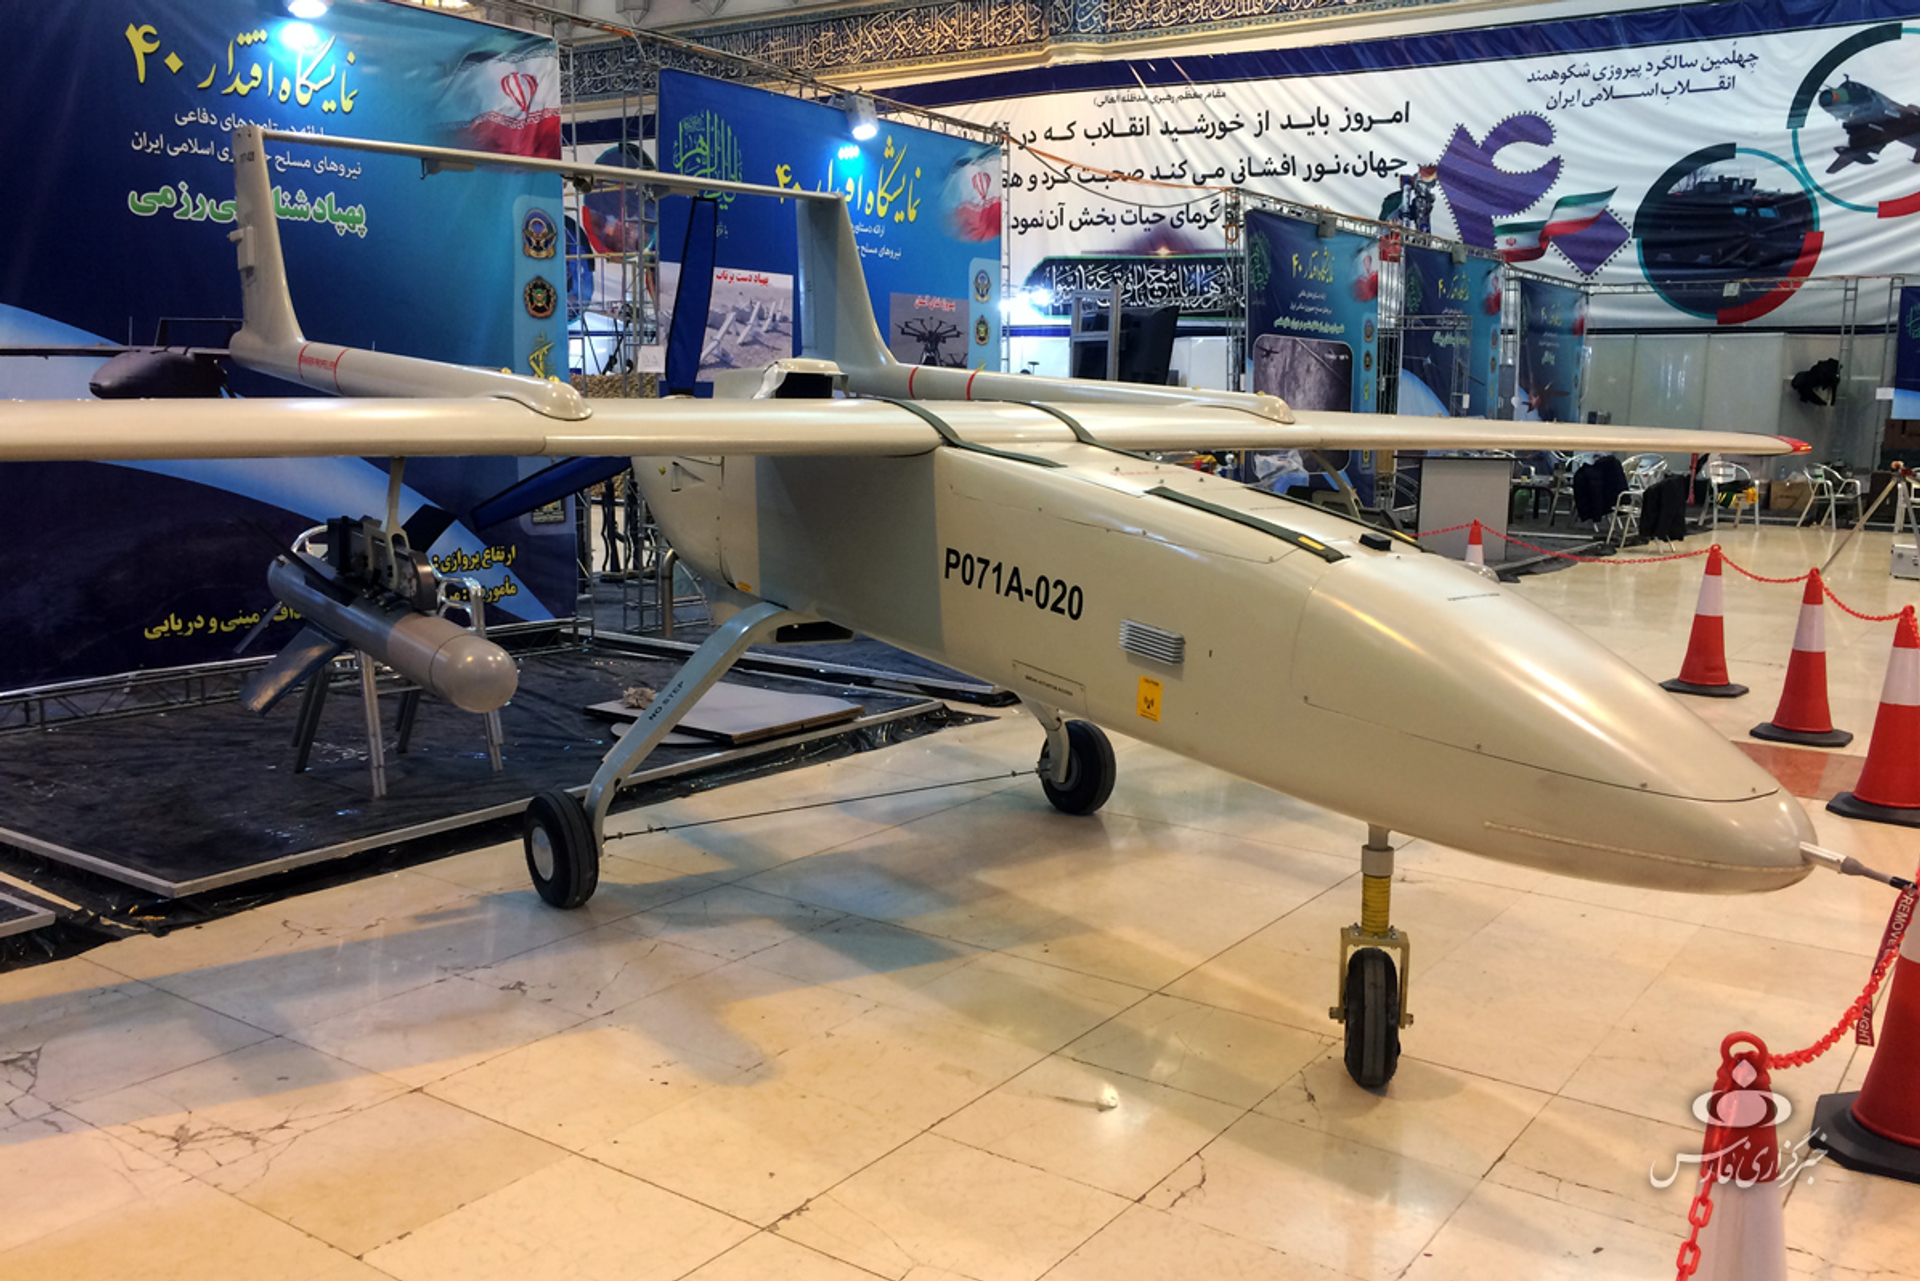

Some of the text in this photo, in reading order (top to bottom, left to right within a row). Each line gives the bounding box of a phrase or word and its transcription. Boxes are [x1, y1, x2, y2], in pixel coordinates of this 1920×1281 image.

[197, 29, 274, 96] اقتدار
[1526, 62, 1591, 85] شکوهمند
[1546, 90, 1581, 111] ایران
[1581, 82, 1659, 108] اسلامی
[174, 107, 217, 126] دفاعی
[1160, 113, 1245, 142] خورشید
[1253, 110, 1270, 138] از
[1279, 106, 1330, 136] باید
[1339, 101, 1410, 132] امروز
[131, 131, 164, 151] ایران
[1018, 129, 1037, 150] در
[1043, 121, 1077, 141] که
[1083, 116, 1151, 147] انقلاب
[166, 138, 214, 156] اسلامی
[274, 151, 311, 173] مسلح
[313, 152, 362, 179] نیروهای
[1150, 160, 1188, 180] کند
[1231, 153, 1297, 185] افشانی
[1027, 172, 1037, 191] و
[1042, 164, 1074, 189] کرد
[1077, 167, 1145, 189] صحبت
[1193, 166, 1226, 185] می
[128, 181, 206, 221] رزمی
[1170, 198, 1221, 229] گرمای
[310, 191, 368, 238] پهپاد
[1011, 213, 1044, 235] نمود
[1046, 203, 1064, 227] آن
[1069, 207, 1116, 232] بخش
[1121, 205, 1166, 232] حیات
[481, 544, 516, 568] ارتفاع
[944, 547, 1084, 620] P071A-020
[144, 613, 205, 639] دریایی
[207, 616, 218, 634] و
[1887, 891, 1913, 946] REMOVE
[1858, 1003, 1872, 1046] LIGHT
